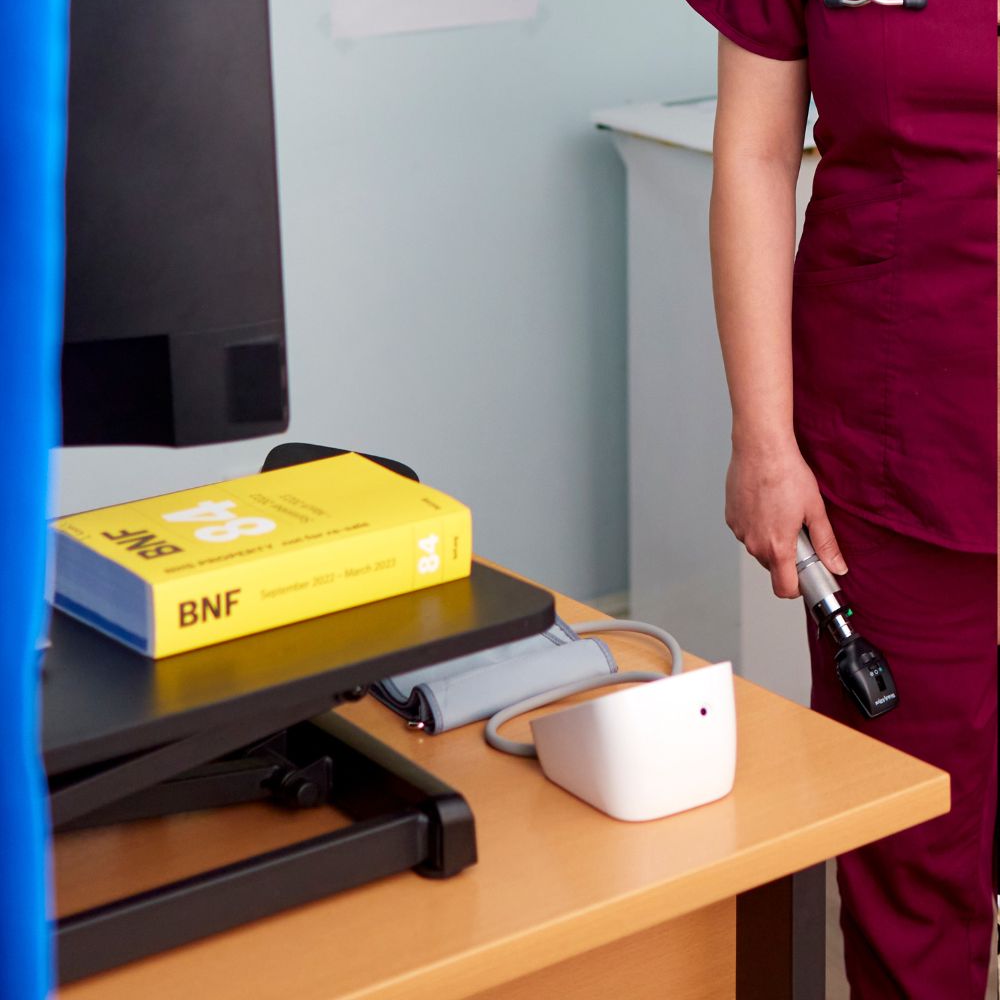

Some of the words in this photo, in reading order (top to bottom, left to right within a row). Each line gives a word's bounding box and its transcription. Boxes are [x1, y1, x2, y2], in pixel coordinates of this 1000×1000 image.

[162, 500, 276, 543] 84
[101, 528, 185, 560] BNF
[416, 534, 440, 575] 84
[178, 588, 242, 629] BNF
[260, 580, 310, 600] September
[344, 562, 372, 578] March
